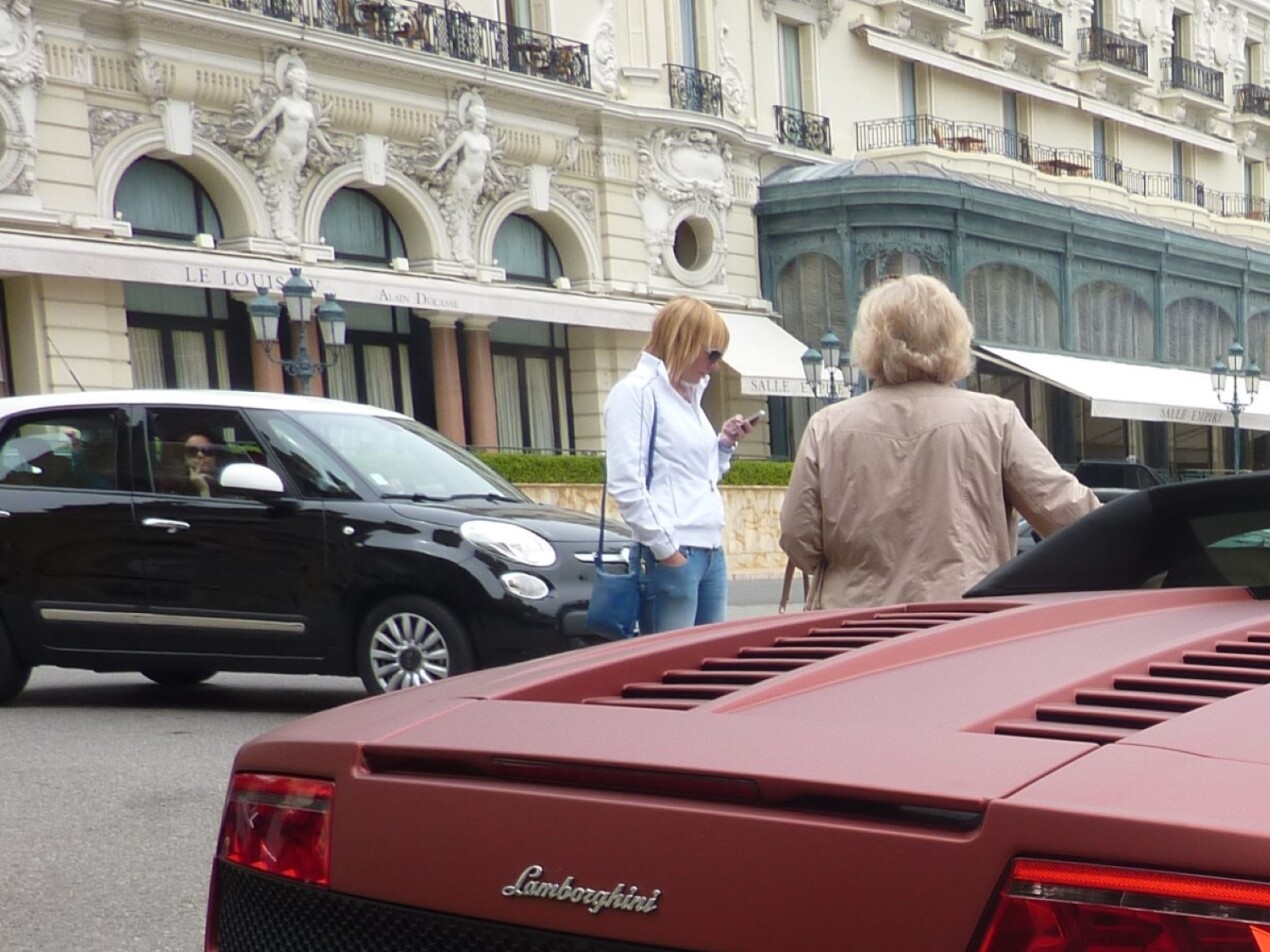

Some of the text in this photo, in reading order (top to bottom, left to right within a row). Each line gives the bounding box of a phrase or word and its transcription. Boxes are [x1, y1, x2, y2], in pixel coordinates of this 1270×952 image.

[184, 266, 211, 284] LE
[221, 269, 286, 292] LOUIS
[750, 379, 791, 393] SALLE
[1160, 407, 1223, 424] SALLE EMPIRE
[502, 864, 661, 914] Lamborghini
